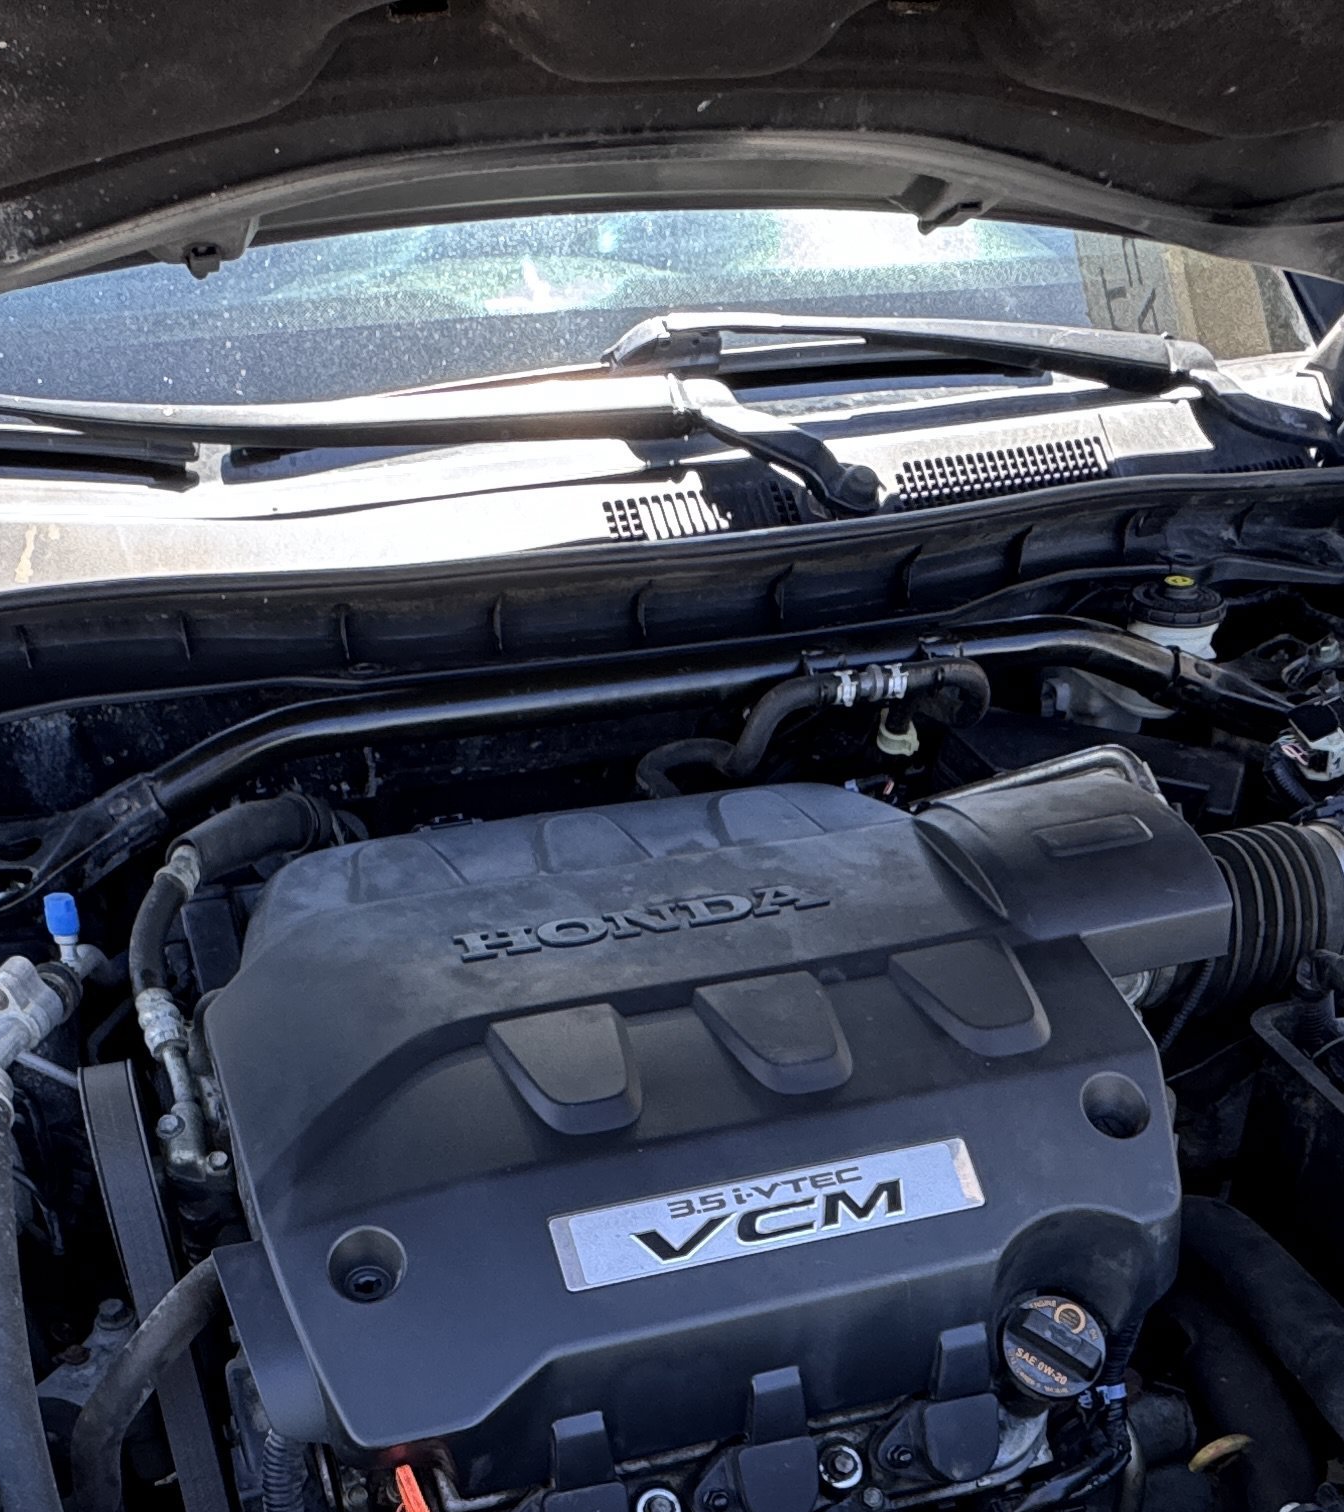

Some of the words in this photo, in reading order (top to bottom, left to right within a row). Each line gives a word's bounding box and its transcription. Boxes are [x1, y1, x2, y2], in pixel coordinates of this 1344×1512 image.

[453, 884, 831, 964] HONDA
[628, 1177, 904, 1264] VCM
[666, 1192, 726, 1219] 3.5
[732, 1166, 863, 1206] i-VTEC
[1015, 1347, 1038, 1367] SAE
[1036, 1361, 1069, 1386] 0W-20
